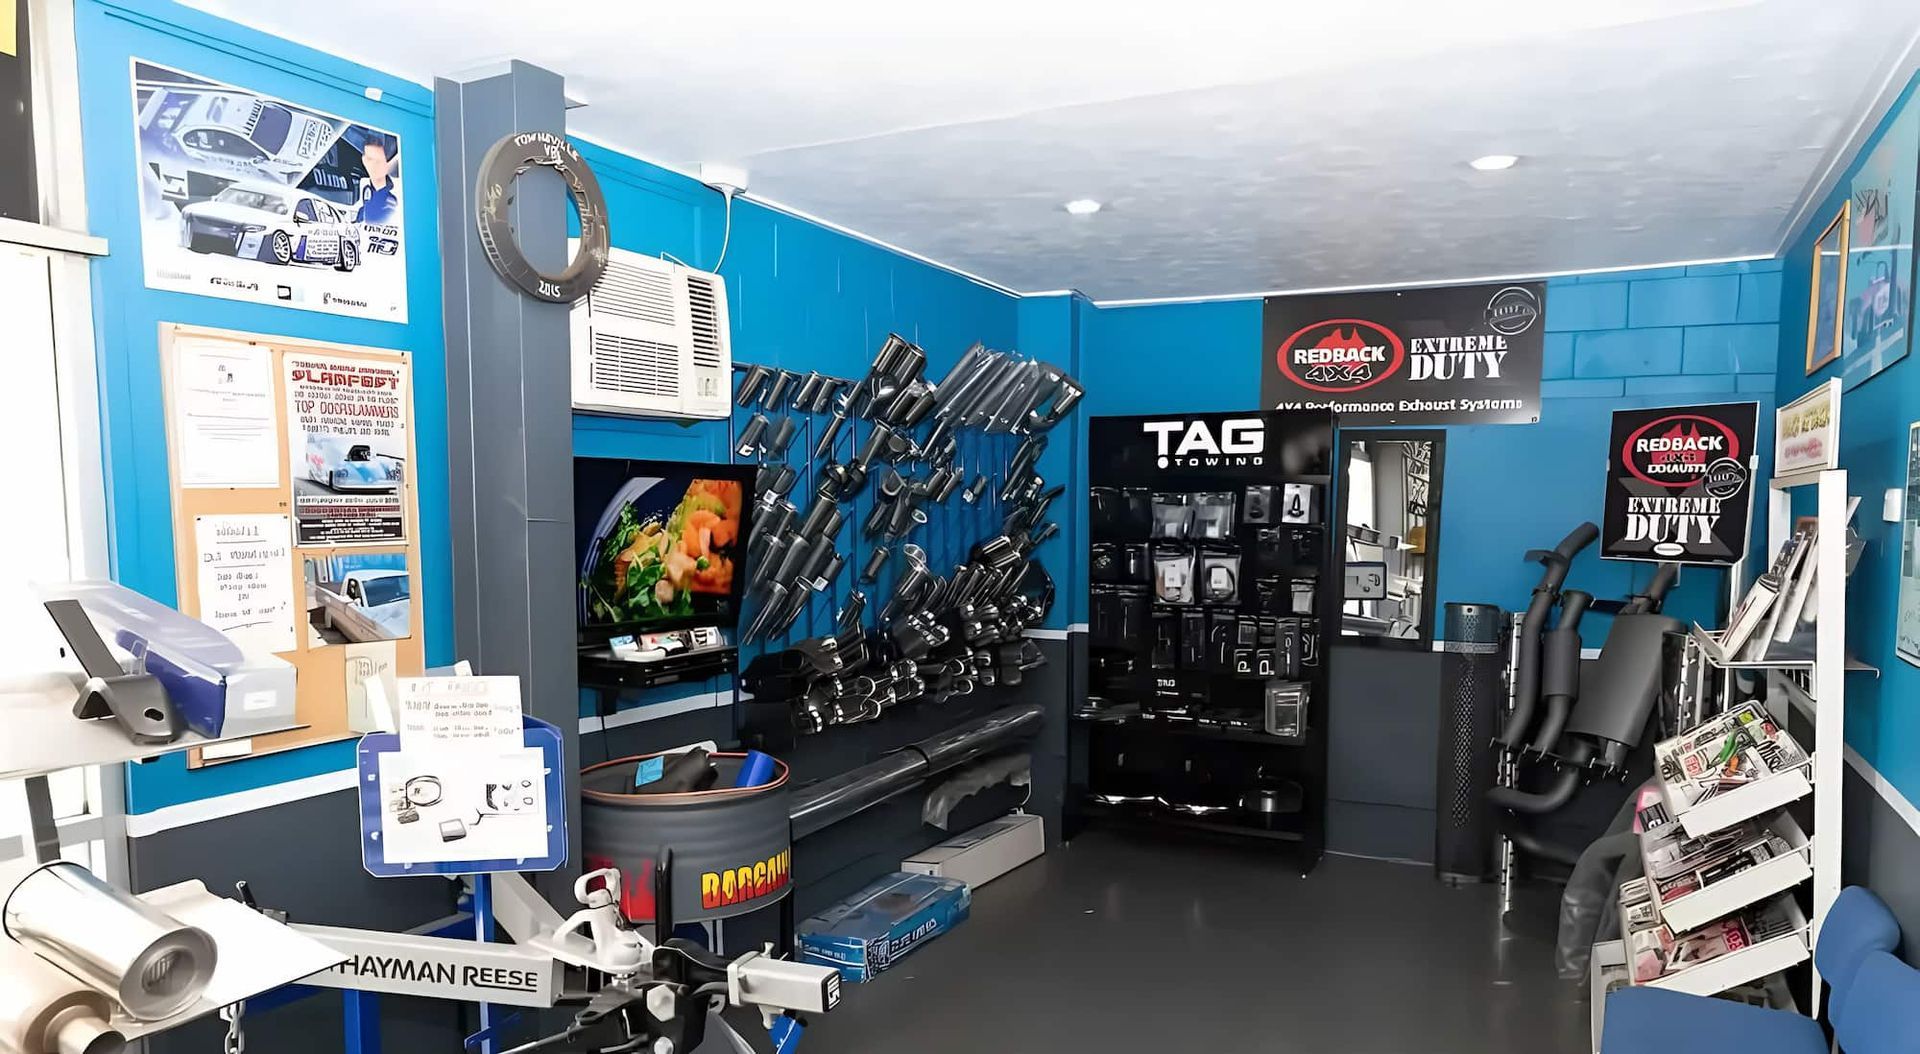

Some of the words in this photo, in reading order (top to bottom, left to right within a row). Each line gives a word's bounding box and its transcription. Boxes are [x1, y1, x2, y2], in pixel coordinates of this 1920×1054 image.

[1410, 335, 1508, 354] EXTREME
[1294, 345, 1386, 365] REDBACK
[1305, 362, 1372, 382] 4X4
[1408, 350, 1508, 381] DUTY
[1399, 399, 1456, 412] Exhaust
[1143, 418, 1265, 456] TAG
[1636, 435, 1724, 453] REDBACK
[1174, 456, 1264, 467] TOWING
[1627, 496, 1721, 515] EXTREME
[1624, 513, 1721, 544] DUTY
[338, 955, 455, 985] HAYMAN
[463, 966, 538, 993] REESE
